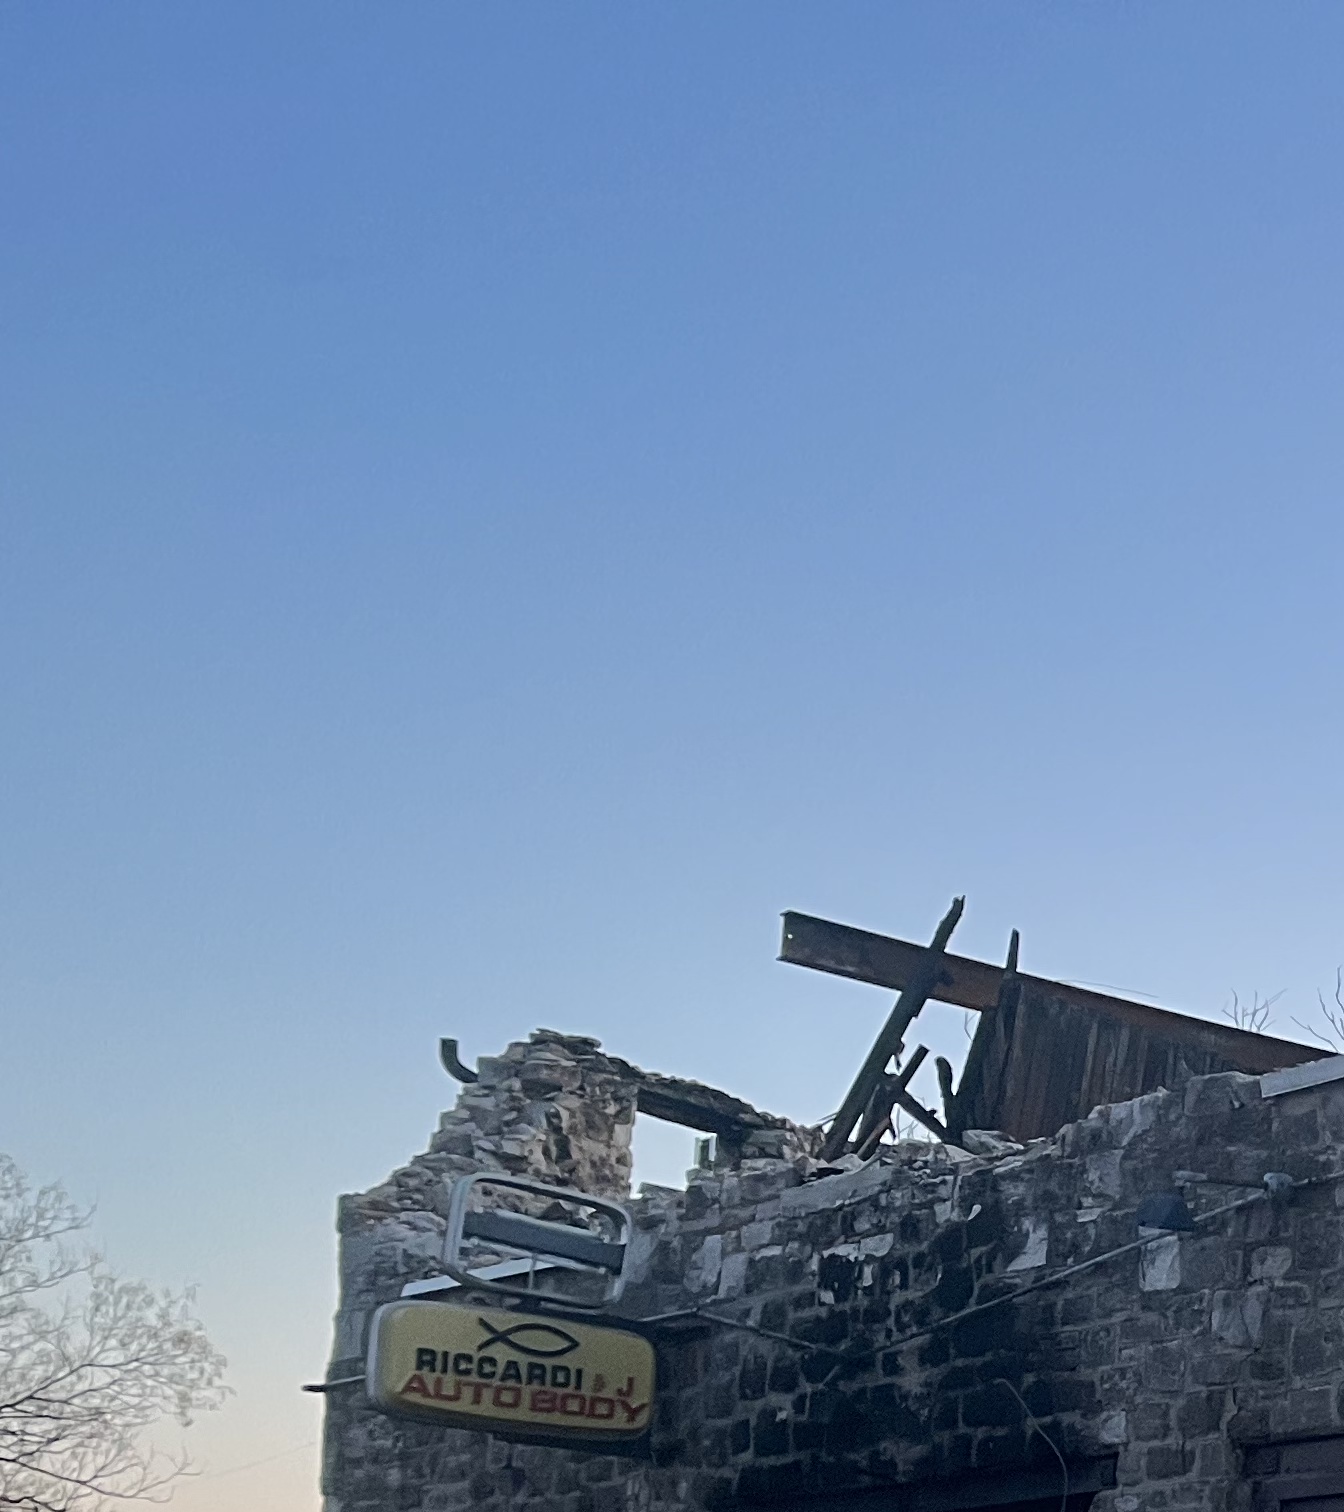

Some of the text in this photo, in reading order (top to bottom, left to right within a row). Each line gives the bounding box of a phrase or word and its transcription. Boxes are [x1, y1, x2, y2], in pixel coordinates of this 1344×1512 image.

[415, 1347, 584, 1391] RICCARDI
[400, 1373, 649, 1424] AUTO BODY
